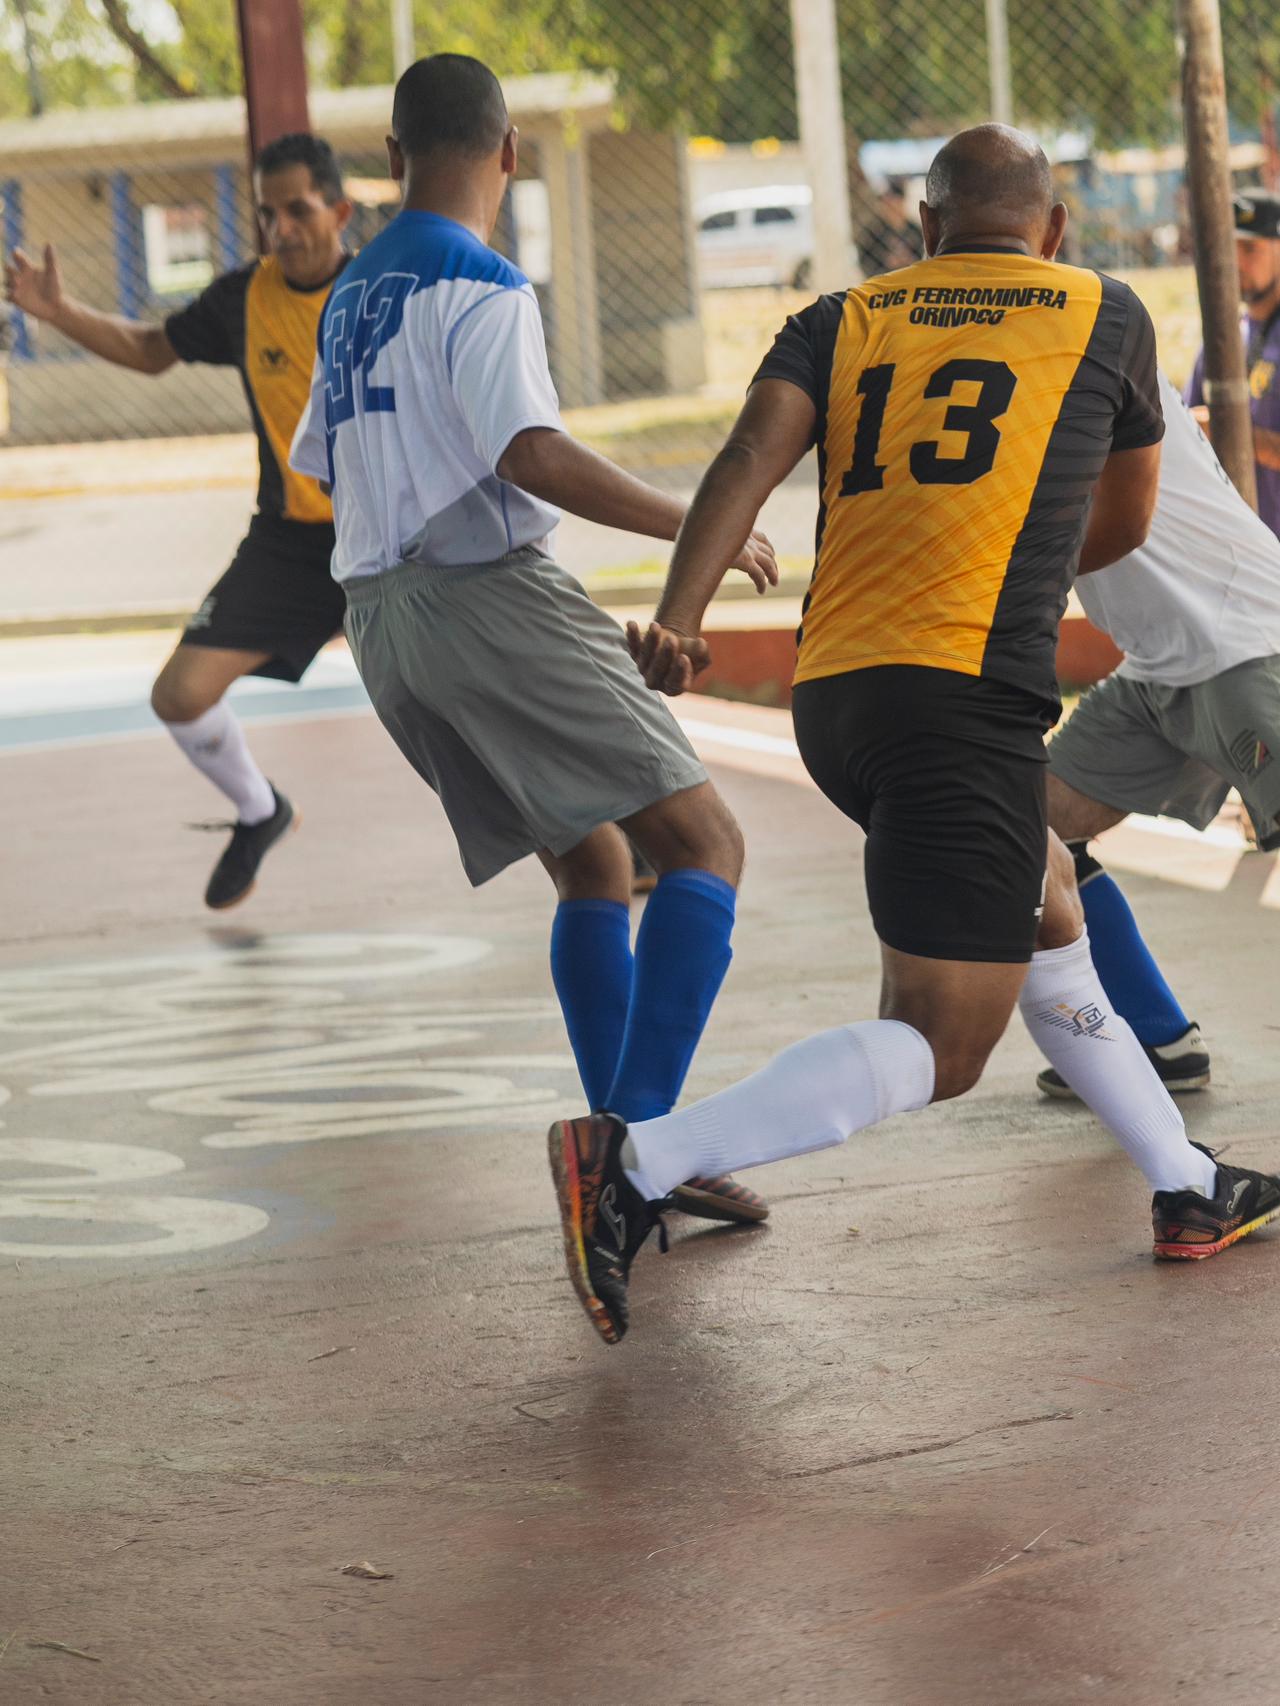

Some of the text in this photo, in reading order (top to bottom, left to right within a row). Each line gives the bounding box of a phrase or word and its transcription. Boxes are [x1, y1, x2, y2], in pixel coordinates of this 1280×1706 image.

[867, 288, 908, 310] CVG
[909, 306, 1006, 328] ORINOCO
[324, 271, 419, 434] 32
[838, 358, 1018, 498] 13
